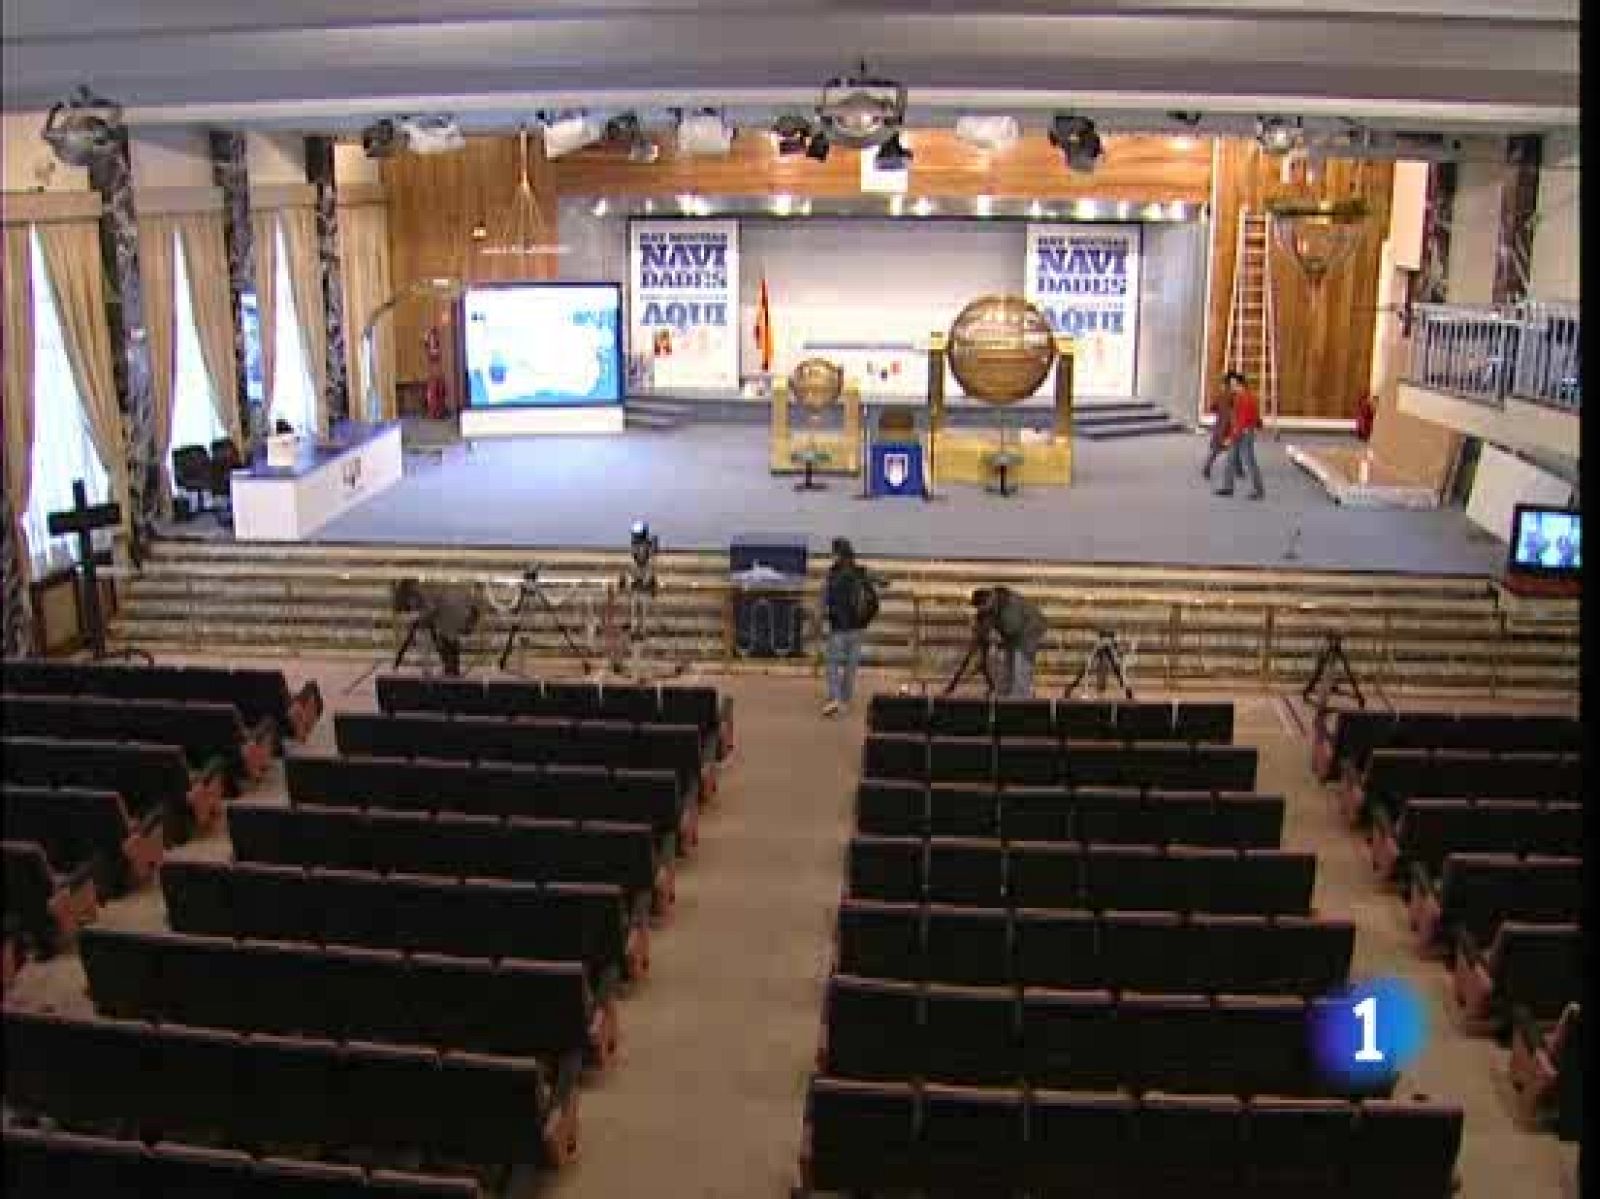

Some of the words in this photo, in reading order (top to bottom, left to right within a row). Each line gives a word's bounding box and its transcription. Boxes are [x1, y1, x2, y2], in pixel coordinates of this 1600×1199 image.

[640, 244, 727, 268] NAVI
[1038, 248, 1127, 274] NAVI
[640, 270, 727, 289] DADES
[1037, 276, 1126, 295] DADES
